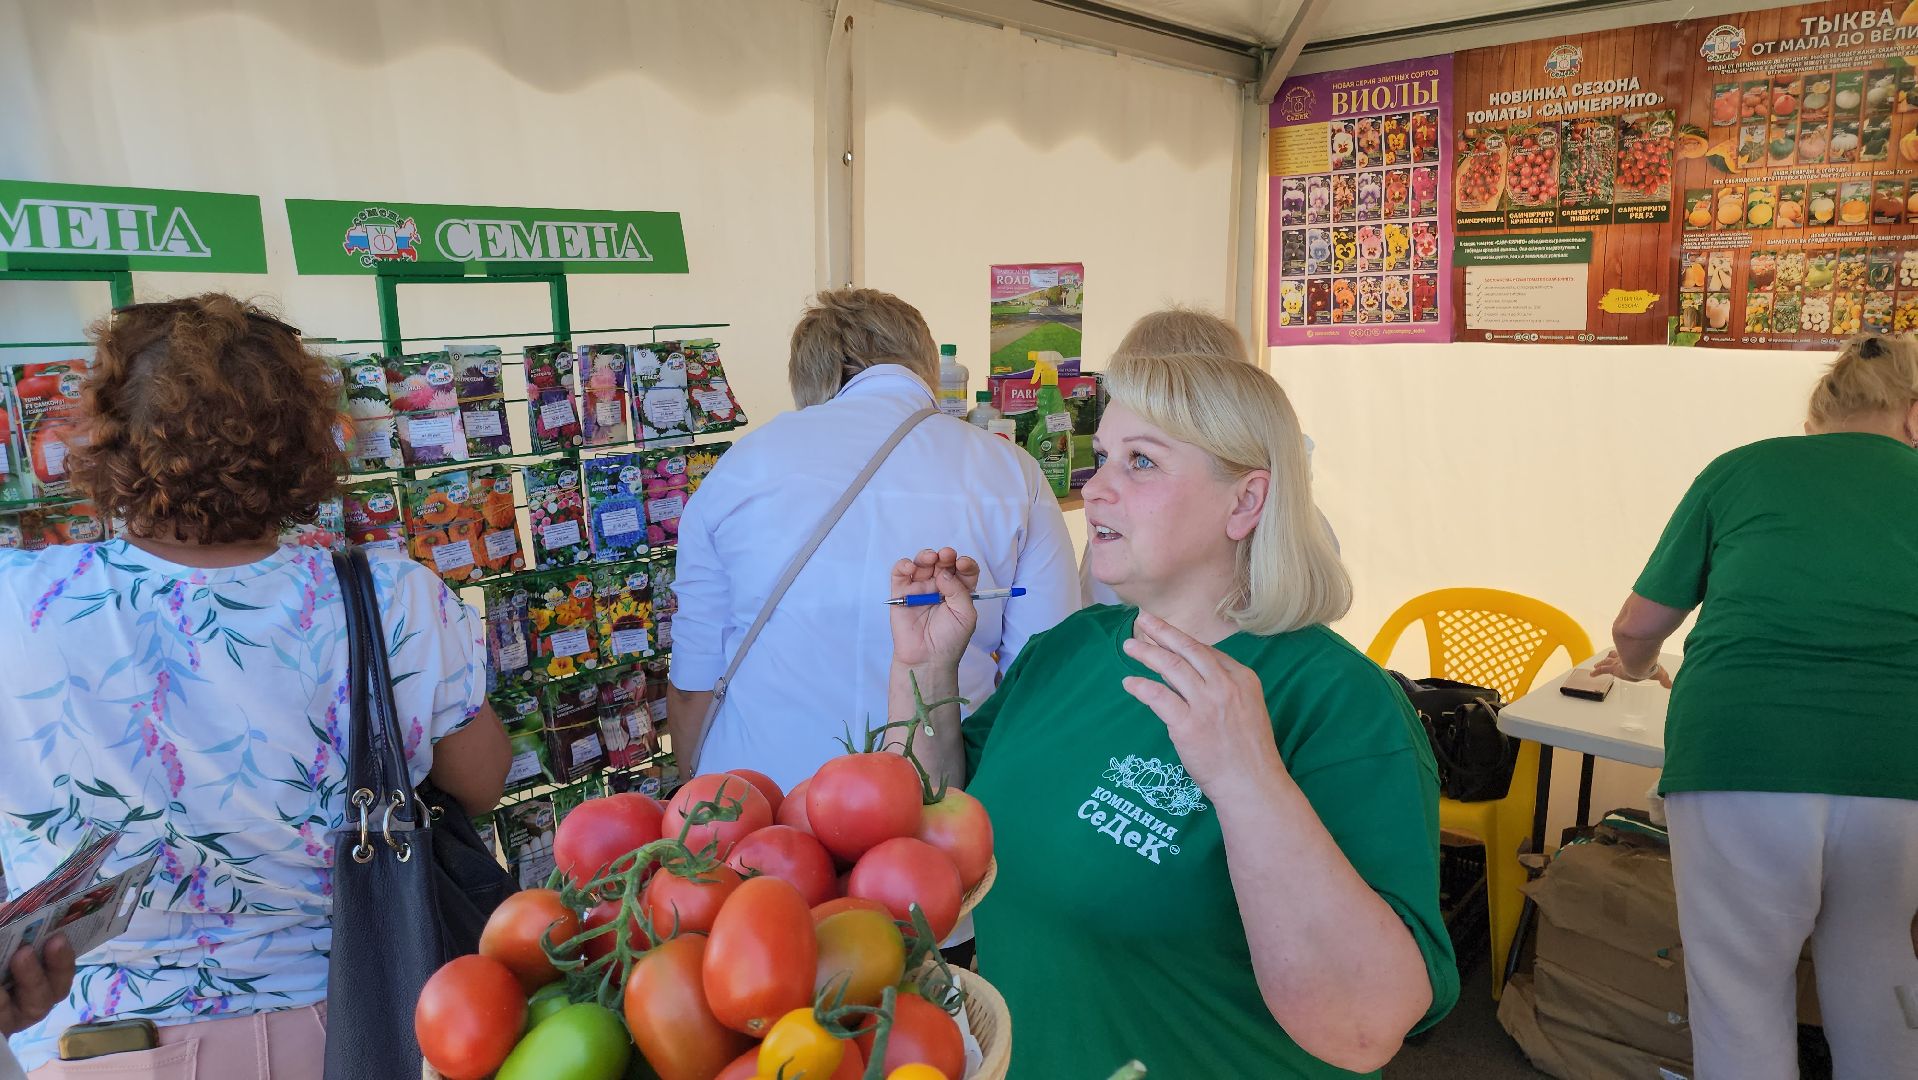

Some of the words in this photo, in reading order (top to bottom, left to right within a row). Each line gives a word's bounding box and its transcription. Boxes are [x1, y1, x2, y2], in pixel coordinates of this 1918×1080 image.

[1801, 8, 1895, 36] ТЫКВА
[1751, 41, 1776, 56] ОТ
[1780, 35, 1831, 53] МАЛА
[1836, 31, 1864, 49] ДО
[1332, 80, 1354, 90] НОВАЯ
[1355, 78, 1376, 87] СЕРИЯ
[1377, 73, 1409, 84] ЭЛИТНЫХ
[1410, 69, 1439, 79] СОРТОВ
[1489, 84, 1568, 106] НОВИНКА
[1571, 76, 1641, 97] СЕЗОНА
[1331, 79, 1440, 116] ВИОЛЫ
[1466, 105, 1532, 125] ТОМАТЫ
[1536, 92, 1665, 117] «САМЧЕРРИТО»
[1509, 210, 1554, 219] САМЧЕРРИТО
[1562, 208, 1609, 217] САМЧЕРРИТО
[1617, 205, 1667, 214] САМЧЕРРИТО
[1629, 212, 1644, 220] РЕД
[435, 218, 653, 262] СЕМЕНА
[996, 275, 1030, 285] ROAD
[1091, 786, 1179, 841] КОМПАНИЯ
[1077, 799, 1169, 865] СеДеК
